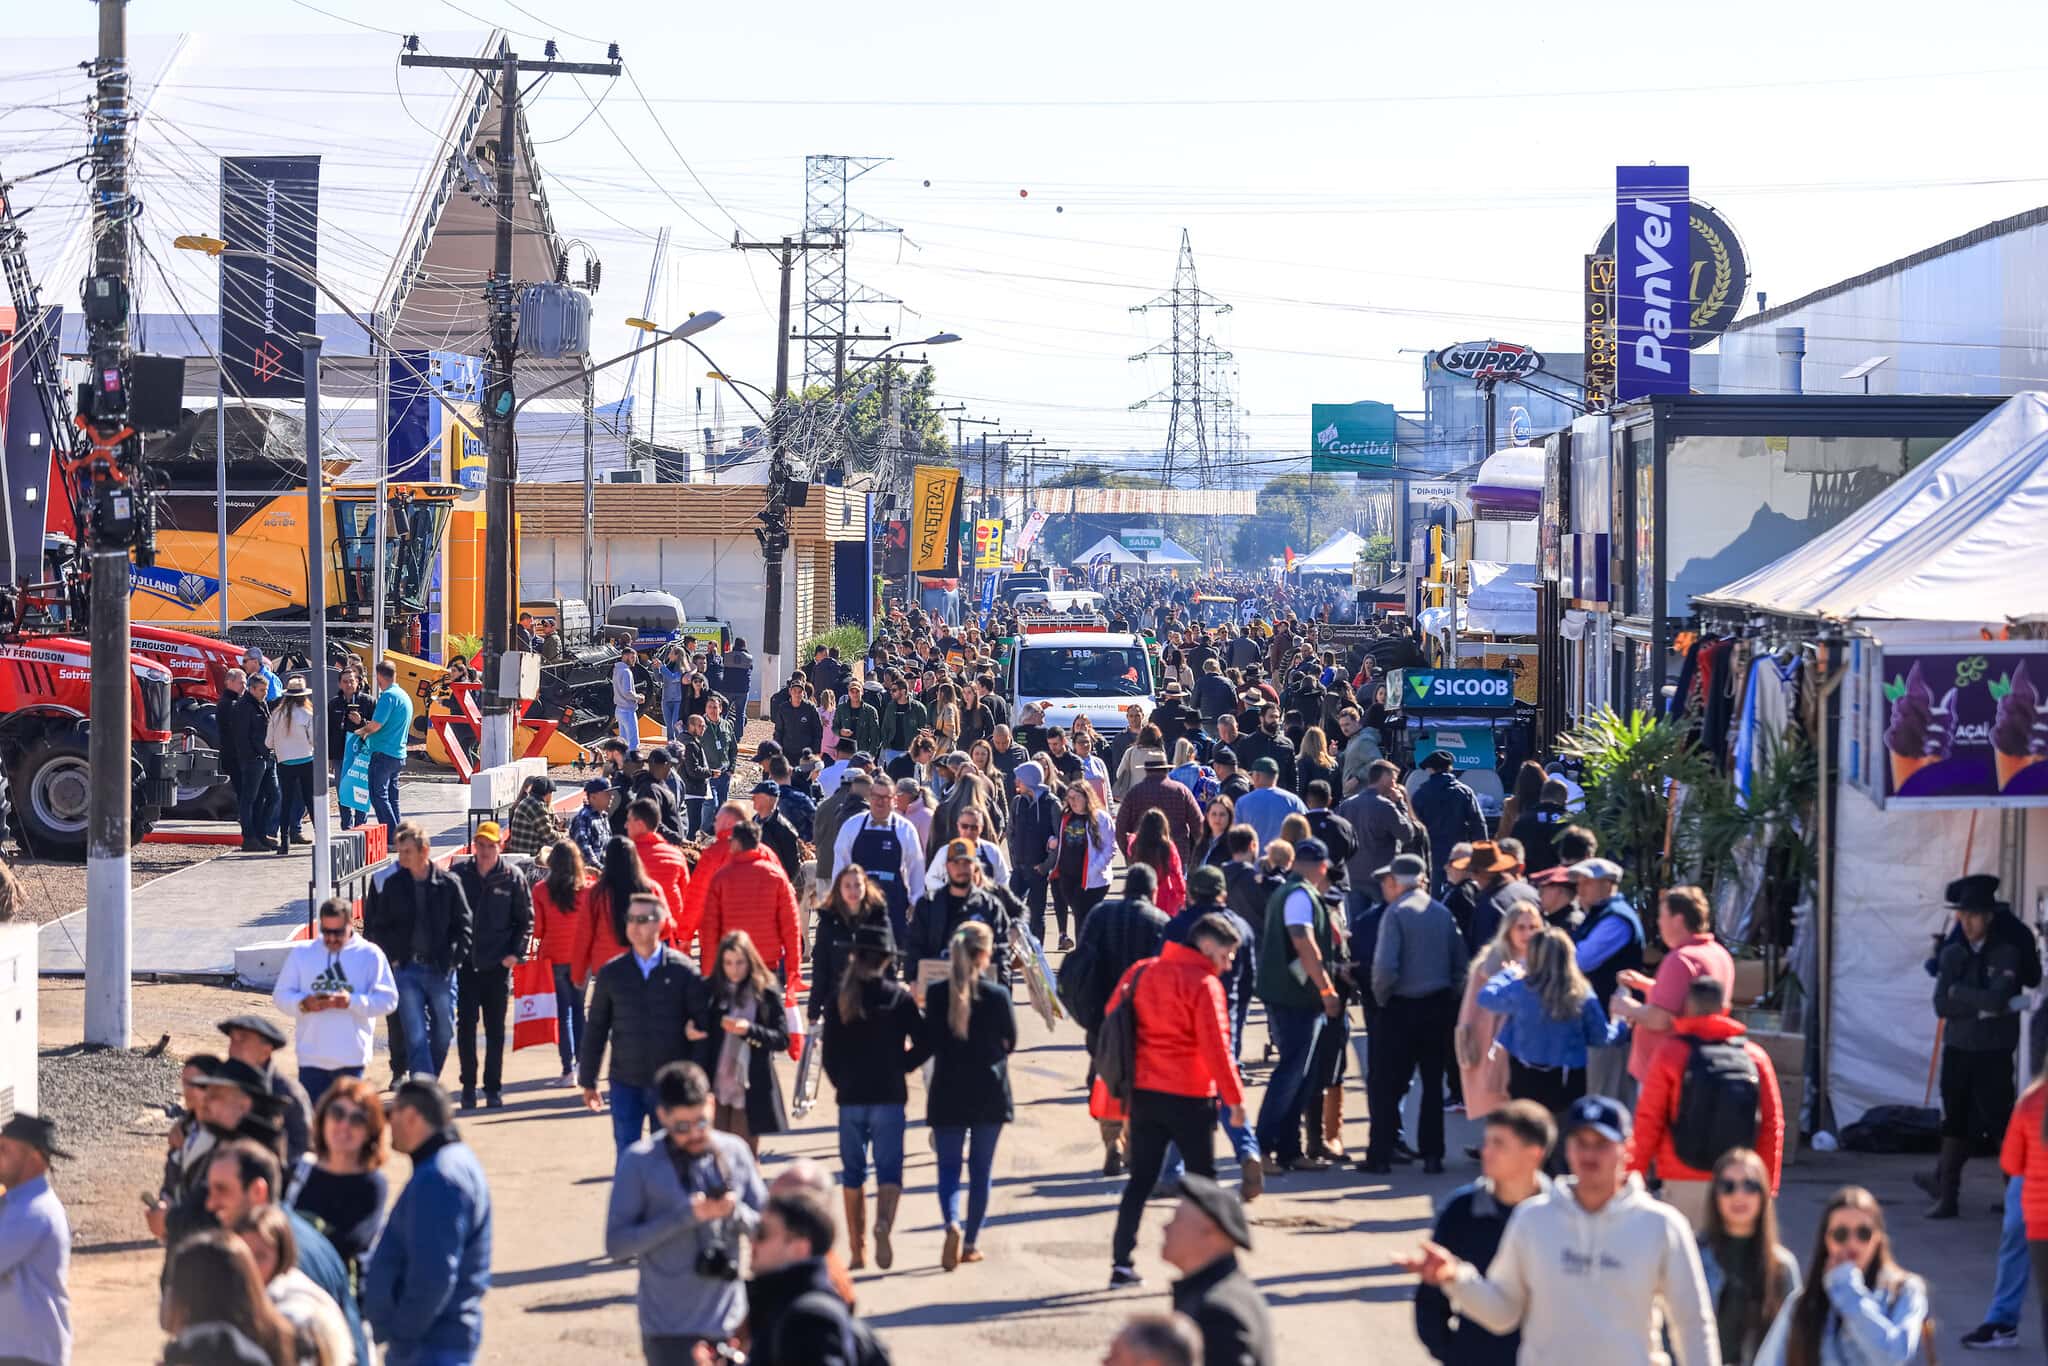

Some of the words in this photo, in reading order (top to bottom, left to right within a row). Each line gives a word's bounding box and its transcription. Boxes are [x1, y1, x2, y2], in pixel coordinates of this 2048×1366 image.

[265, 268, 275, 334] MASSEY
[1449, 350, 1534, 371] SUPRA
[919, 479, 946, 562] VALTRA
[1128, 536, 1156, 546] SAÍDA
[129, 574, 178, 595] HOLLAND
[14, 649, 65, 662] FERGUSON
[131, 639, 178, 653] FERGUSON
[1434, 679, 1509, 696] SICOOB
